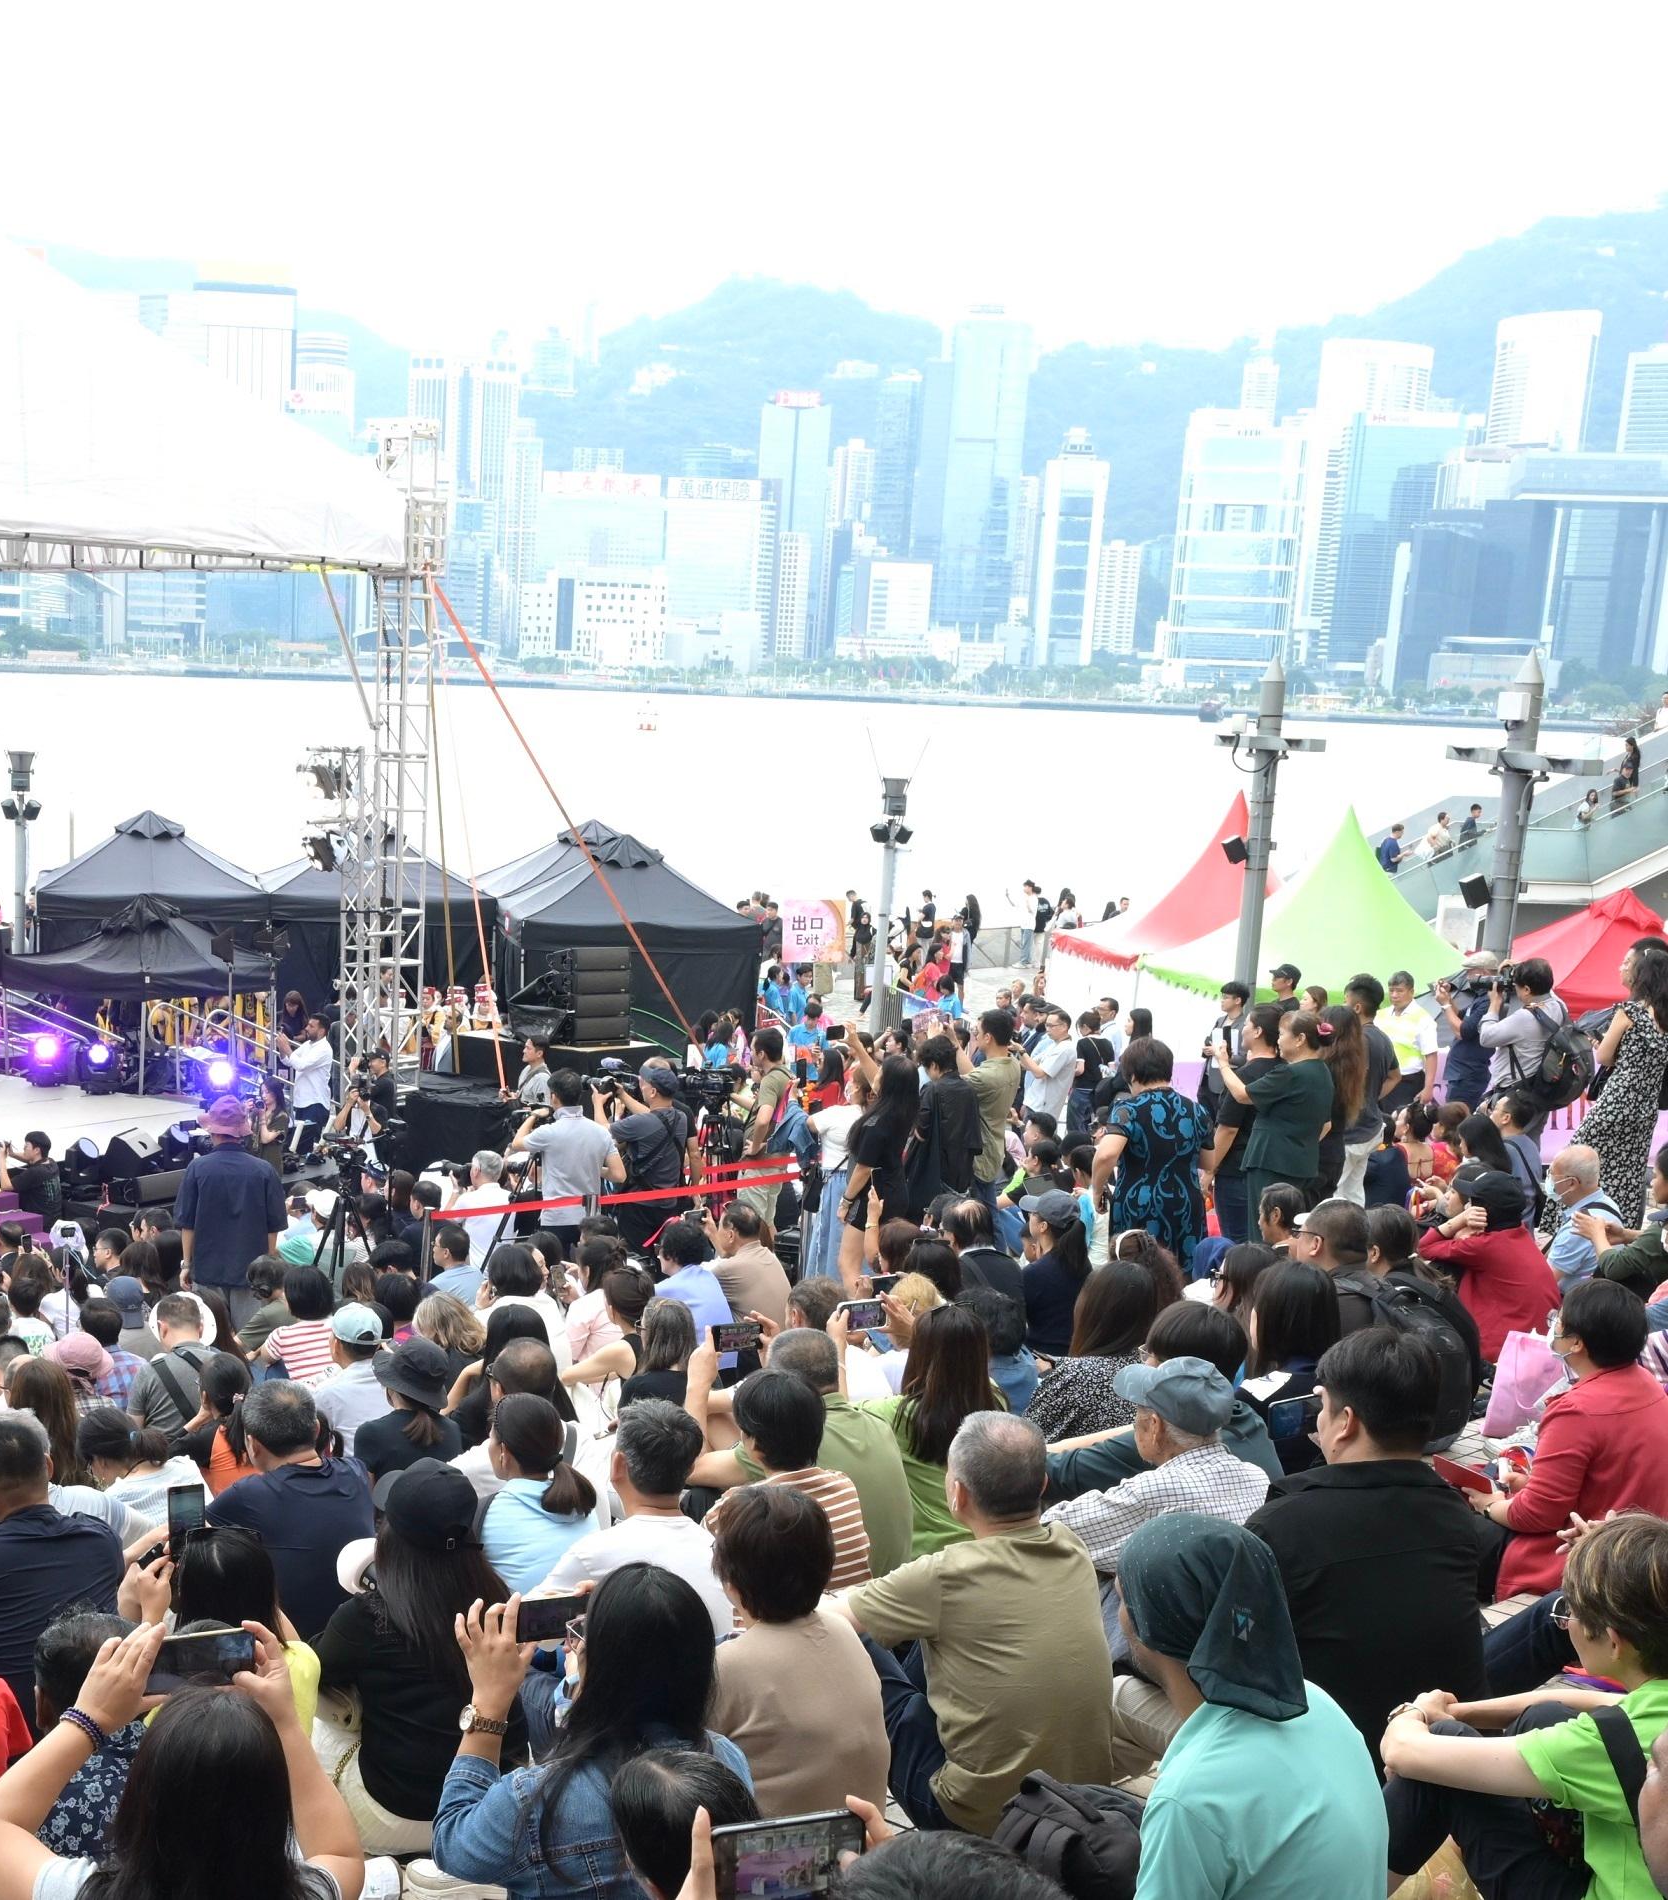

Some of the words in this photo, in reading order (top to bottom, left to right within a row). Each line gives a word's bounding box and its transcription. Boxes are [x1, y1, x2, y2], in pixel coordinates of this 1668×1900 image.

[678, 480, 750, 500] 萬通保險
[792, 915, 823, 931] 出口
[796, 934, 819, 945] Exit
